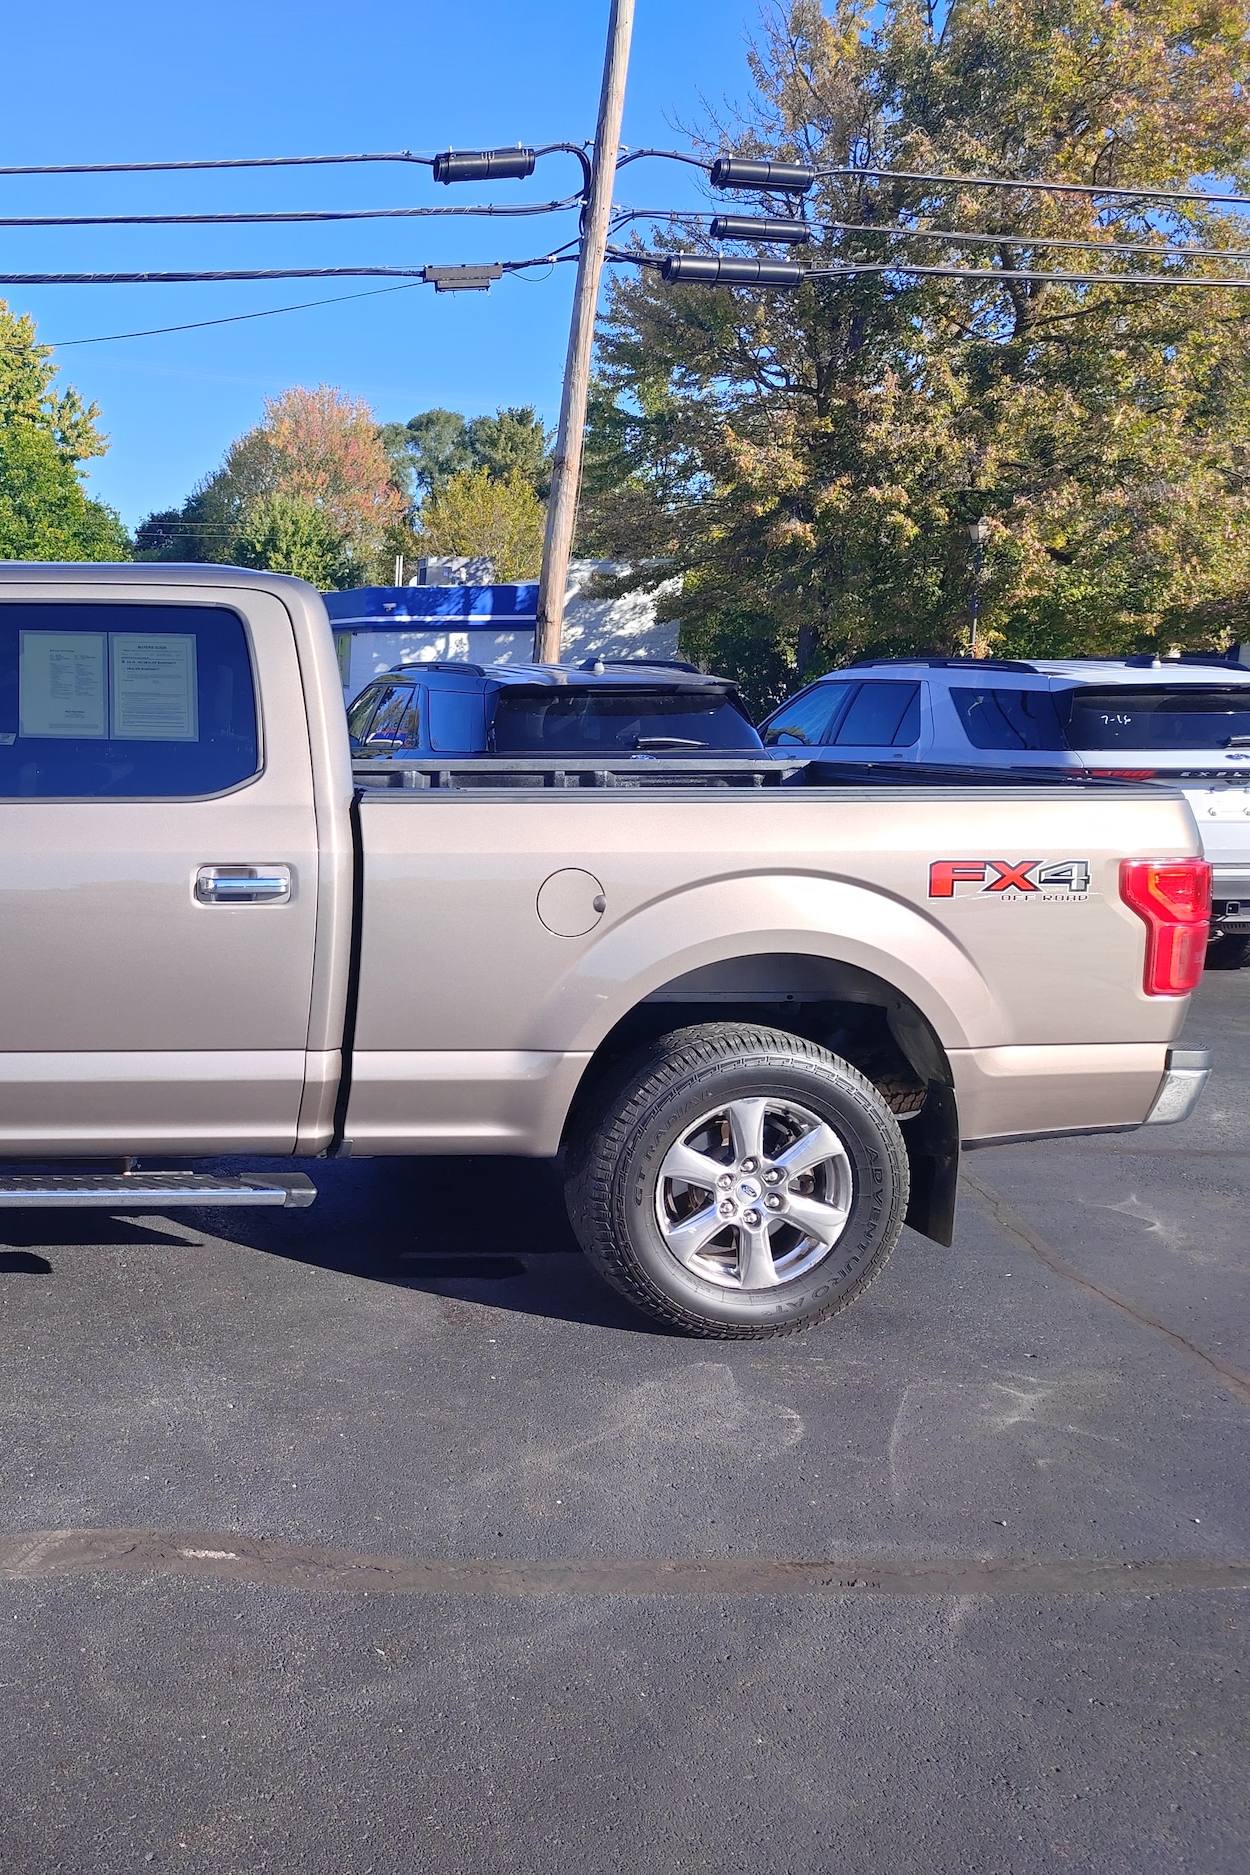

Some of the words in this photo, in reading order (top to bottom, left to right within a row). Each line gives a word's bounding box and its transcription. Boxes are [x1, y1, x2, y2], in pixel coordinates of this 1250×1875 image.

[928, 858, 1091, 899] FX4
[1000, 894, 1036, 902] OFF
[1042, 894, 1089, 902] ROAD
[811, 1145, 884, 1299] ADVENTURO
